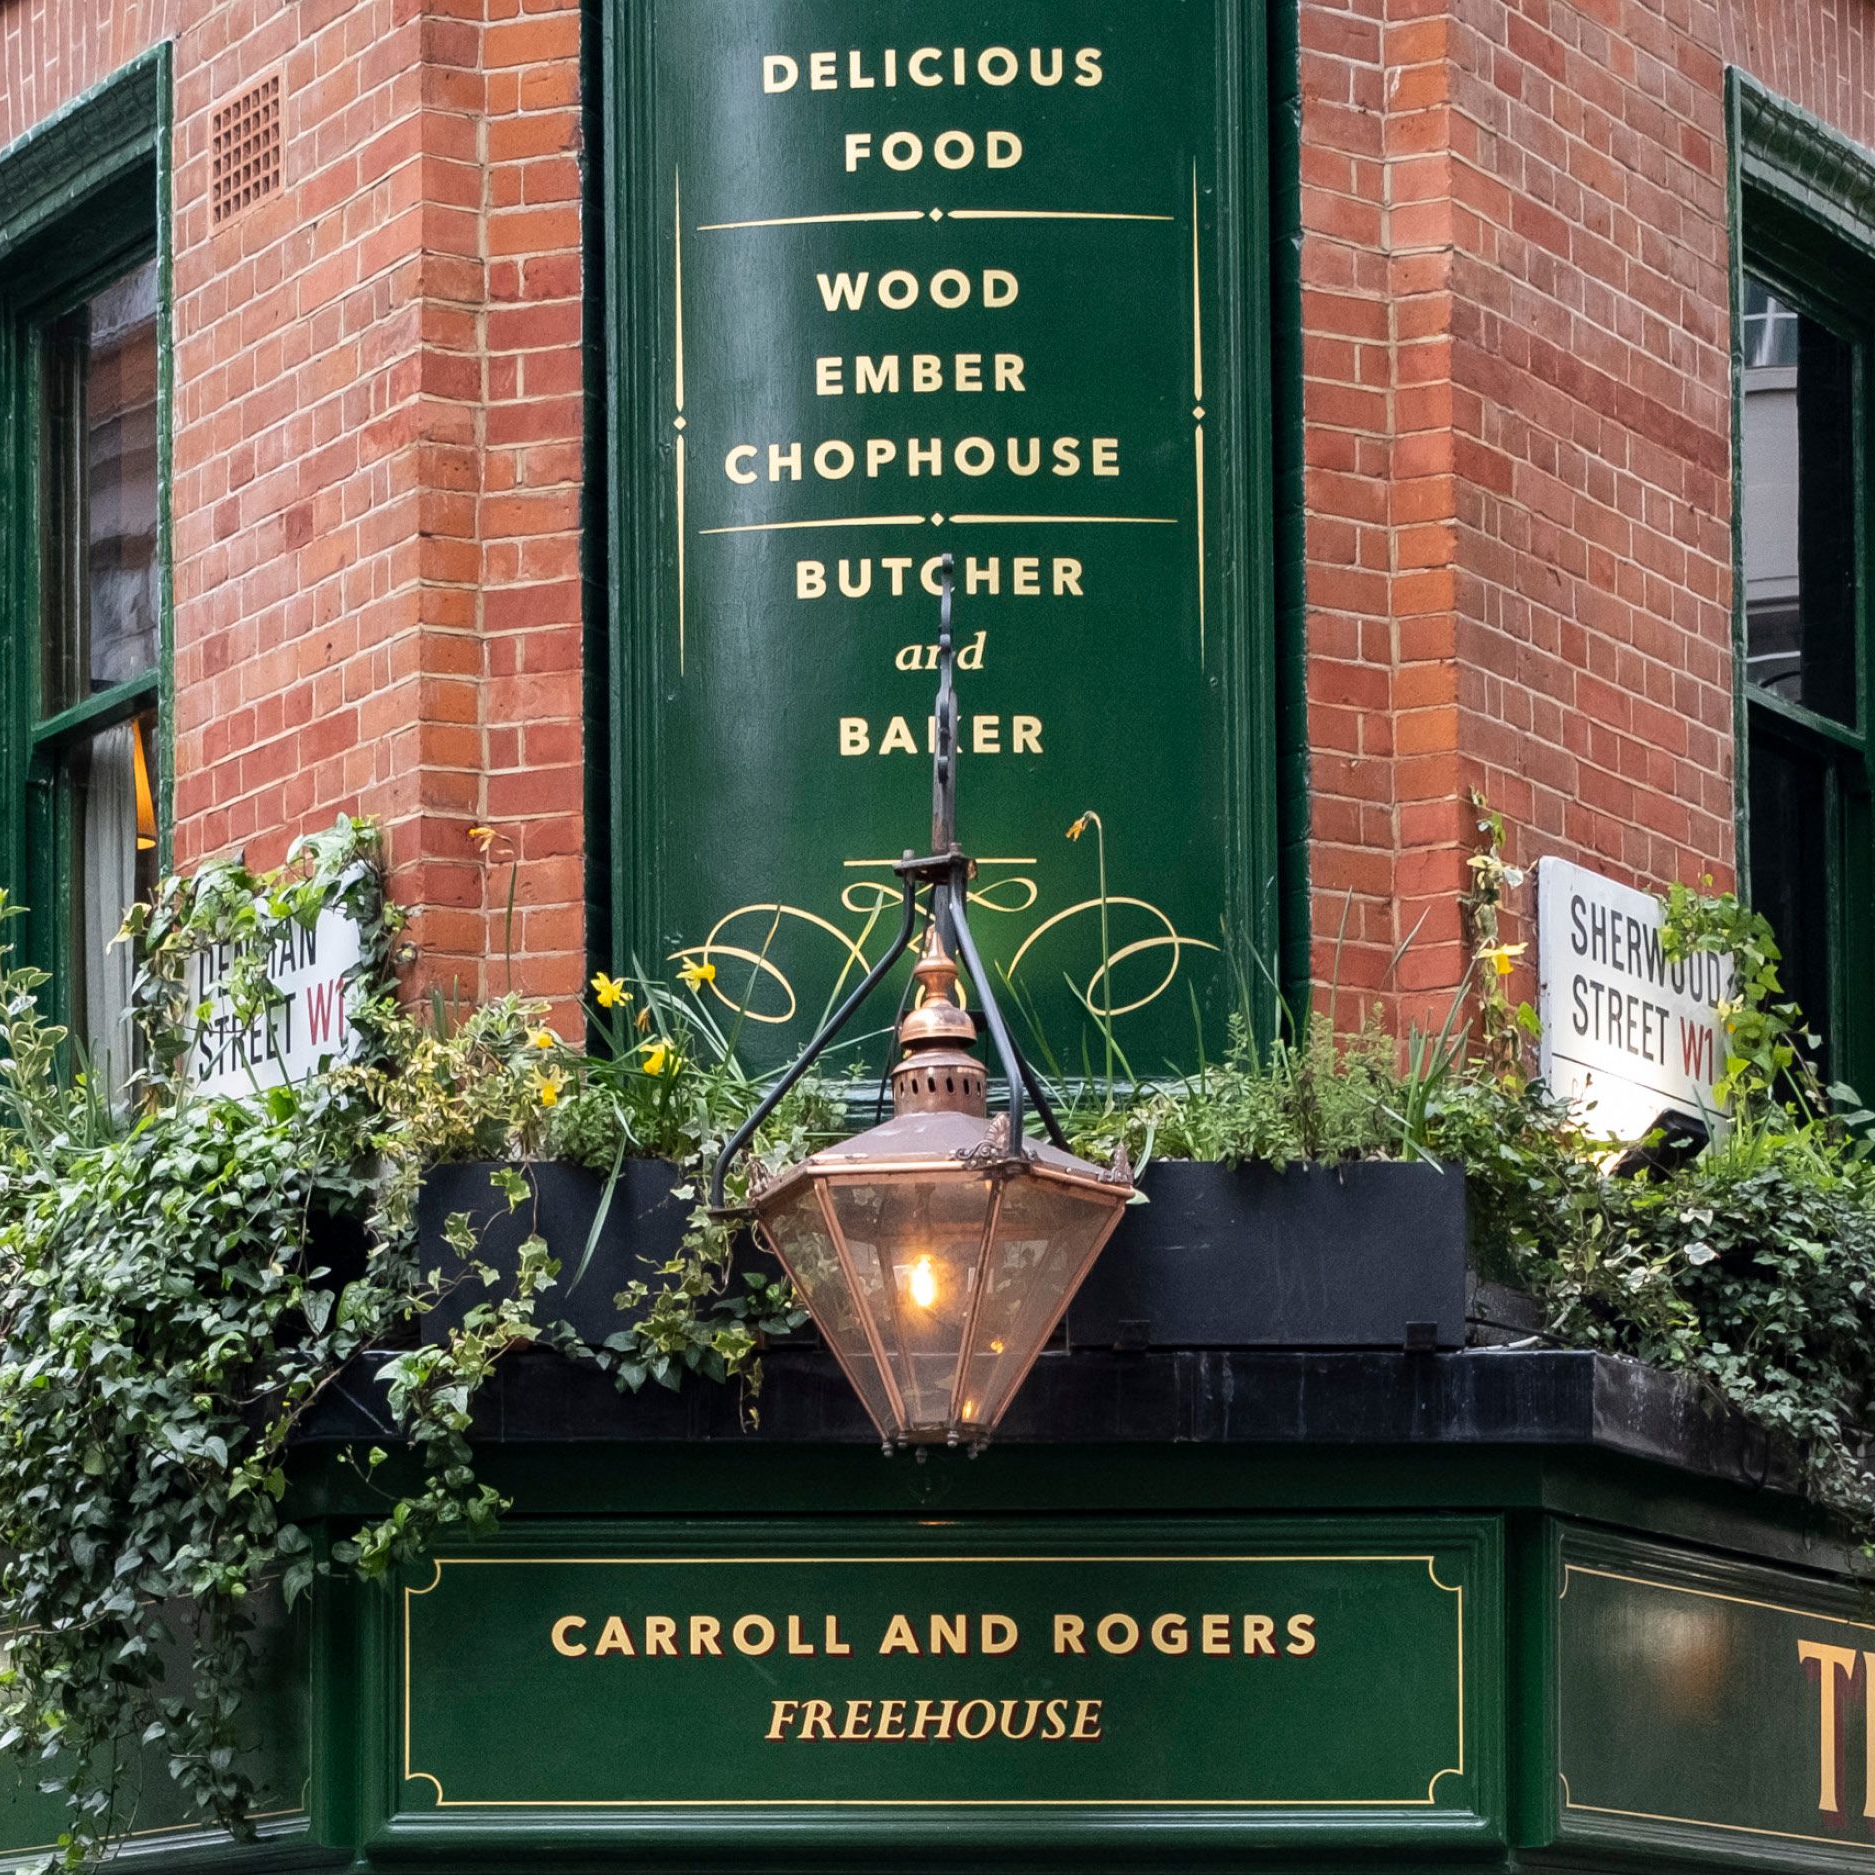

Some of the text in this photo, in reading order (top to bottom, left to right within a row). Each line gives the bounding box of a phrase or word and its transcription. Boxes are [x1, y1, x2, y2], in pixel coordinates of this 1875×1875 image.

[763, 46, 1105, 94] DELICIOUS
[845, 130, 1023, 173] FOOD
[816, 269, 1019, 312] WOOD
[816, 353, 1026, 396] EMBER
[725, 437, 1121, 486] CHOPHOUSE
[796, 557, 1084, 599] BUTCHER
[199, 915, 316, 1003] DEAN
[1571, 894, 1721, 1010] SHERWOOD
[307, 976, 344, 1046] W1
[1572, 974, 1713, 1086] STREET W1
[551, 1612, 1320, 1657] CARROLL AND ROGERS
[765, 1697, 1104, 1743] FREEHOUSE
